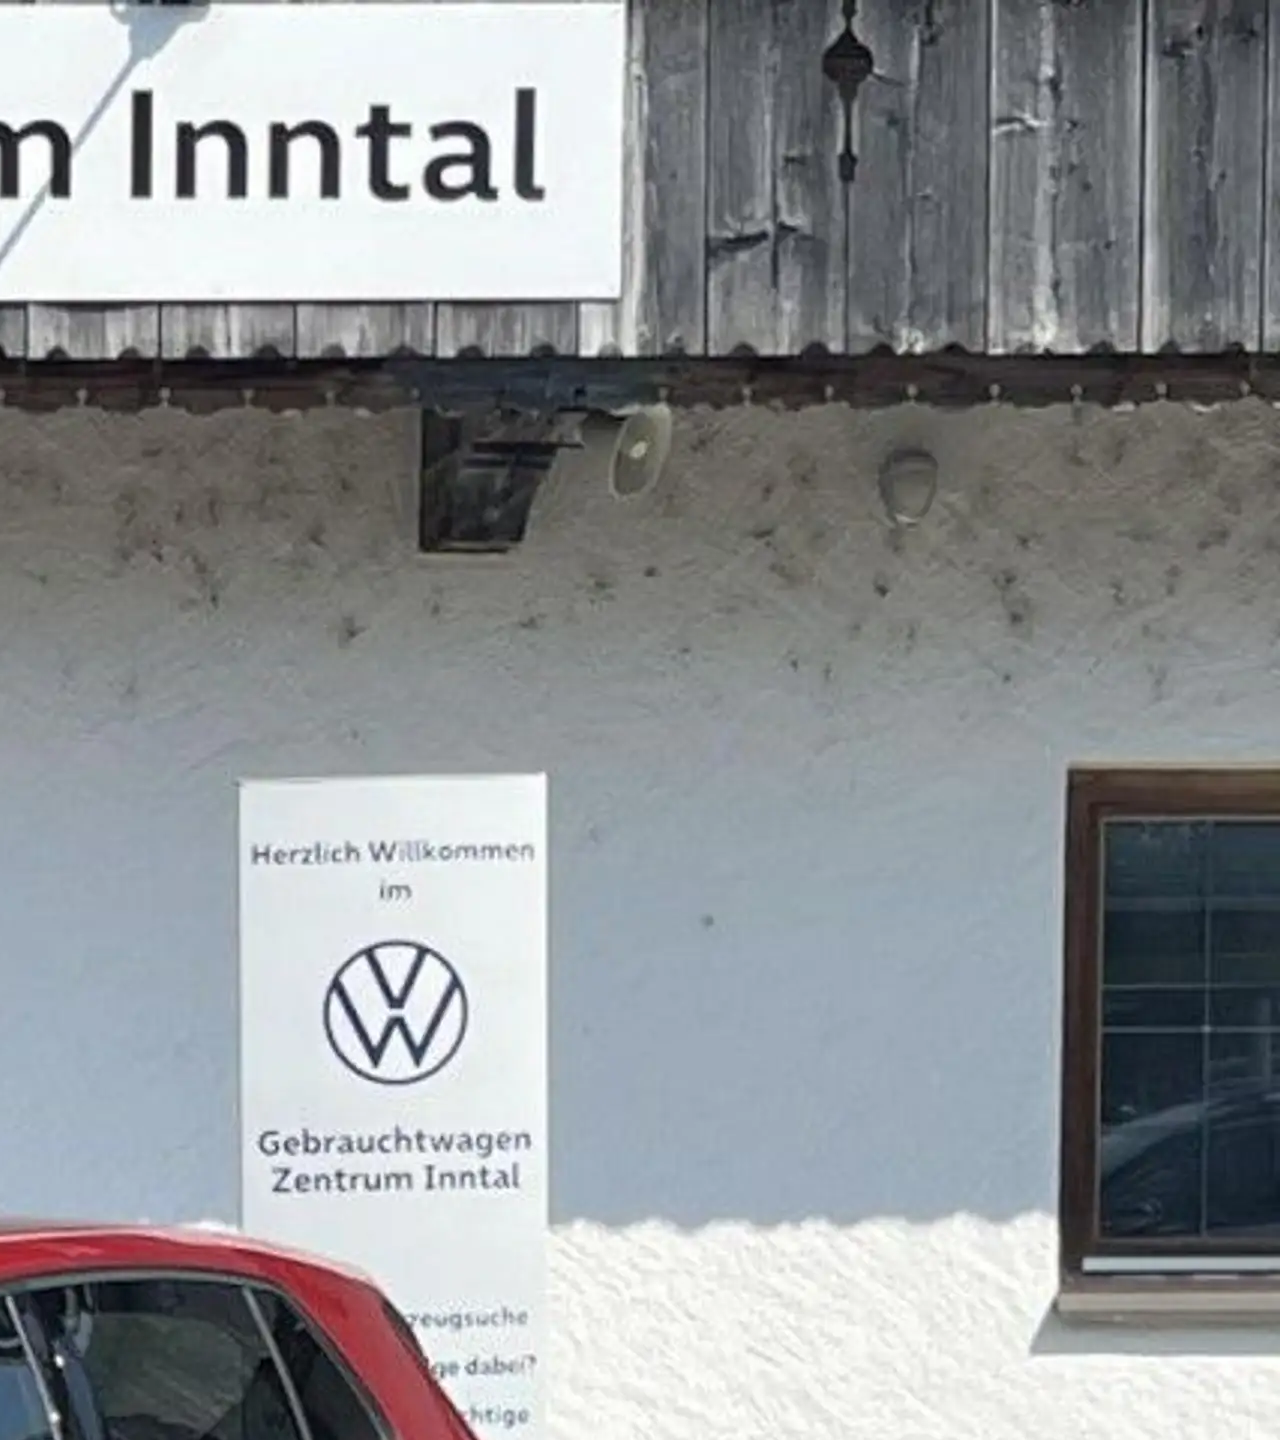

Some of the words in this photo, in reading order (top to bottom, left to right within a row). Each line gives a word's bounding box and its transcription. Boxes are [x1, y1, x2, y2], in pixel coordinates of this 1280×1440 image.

[130, 87, 545, 202] Inntal
[250, 840, 362, 867] Herzlich
[367, 839, 536, 865] Willkommen
[378, 878, 413, 901] im
[323, 939, 469, 1086] VW
[256, 1125, 533, 1159] Gebrauchtwagen
[271, 1165, 414, 1194] Zentrum
[424, 1162, 521, 1191] Inntal
